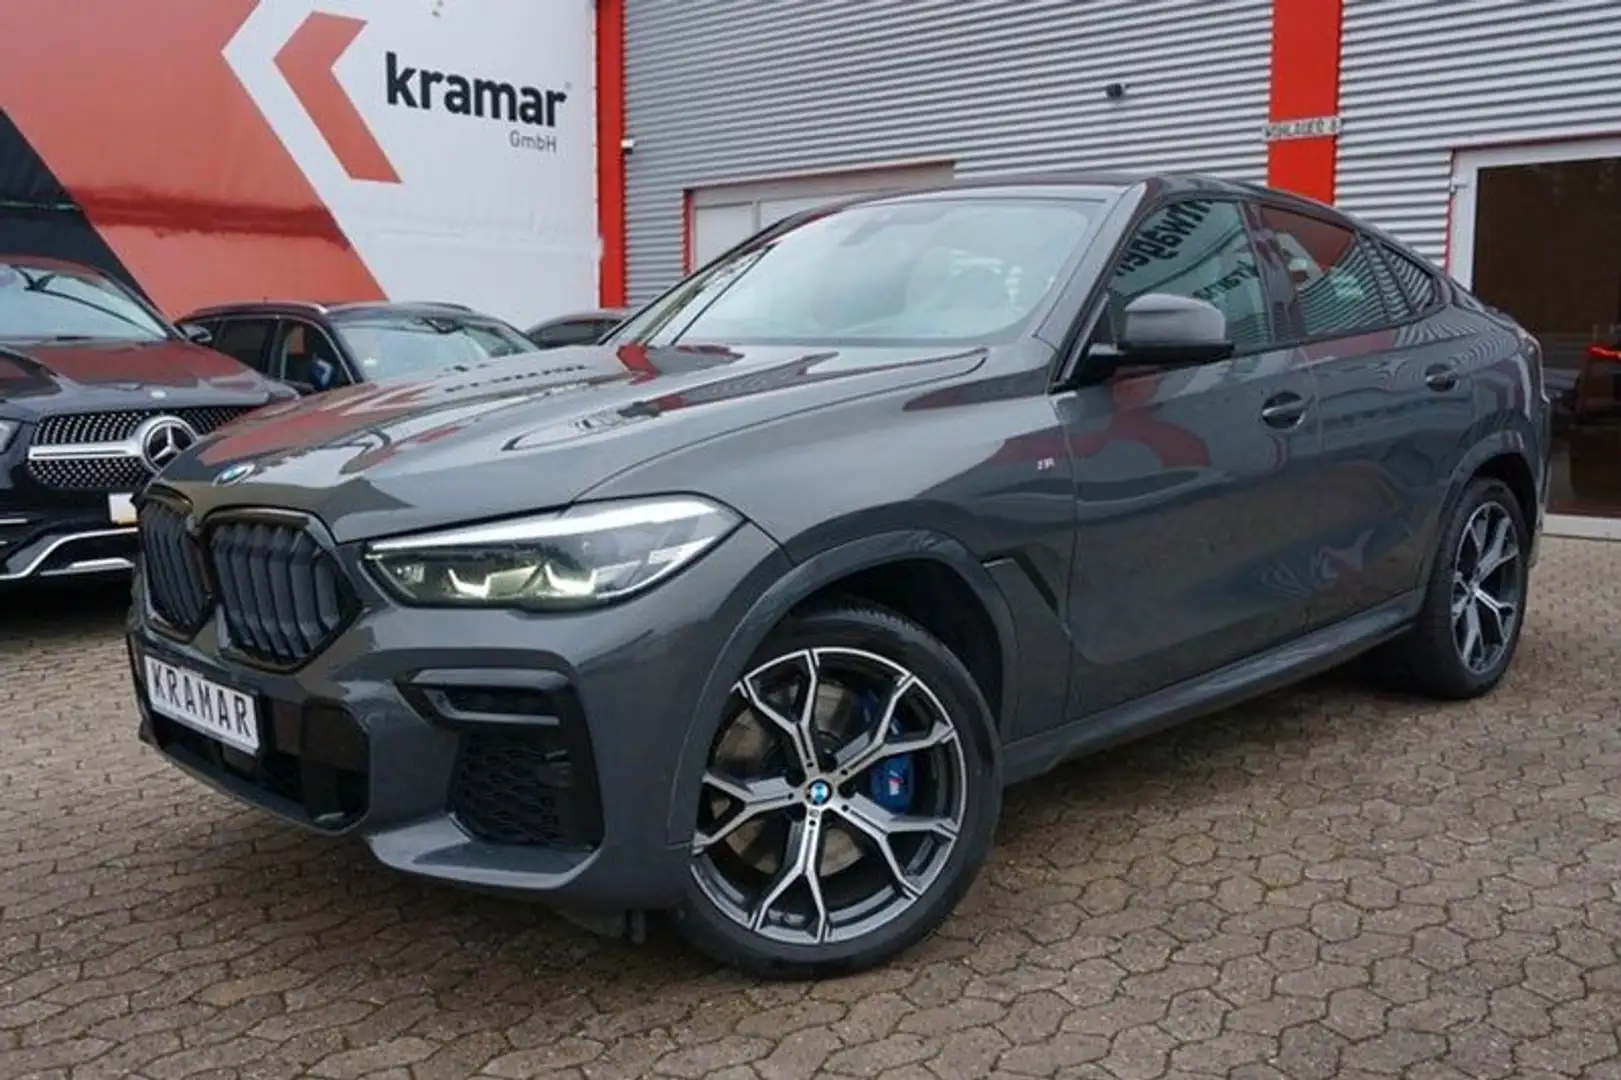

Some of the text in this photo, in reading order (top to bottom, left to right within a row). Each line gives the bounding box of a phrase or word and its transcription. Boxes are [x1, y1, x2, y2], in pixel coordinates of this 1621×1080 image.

[385, 50, 567, 127] kramar
[509, 130, 557, 153] GmbH
[150, 661, 252, 738] KRAMAR
